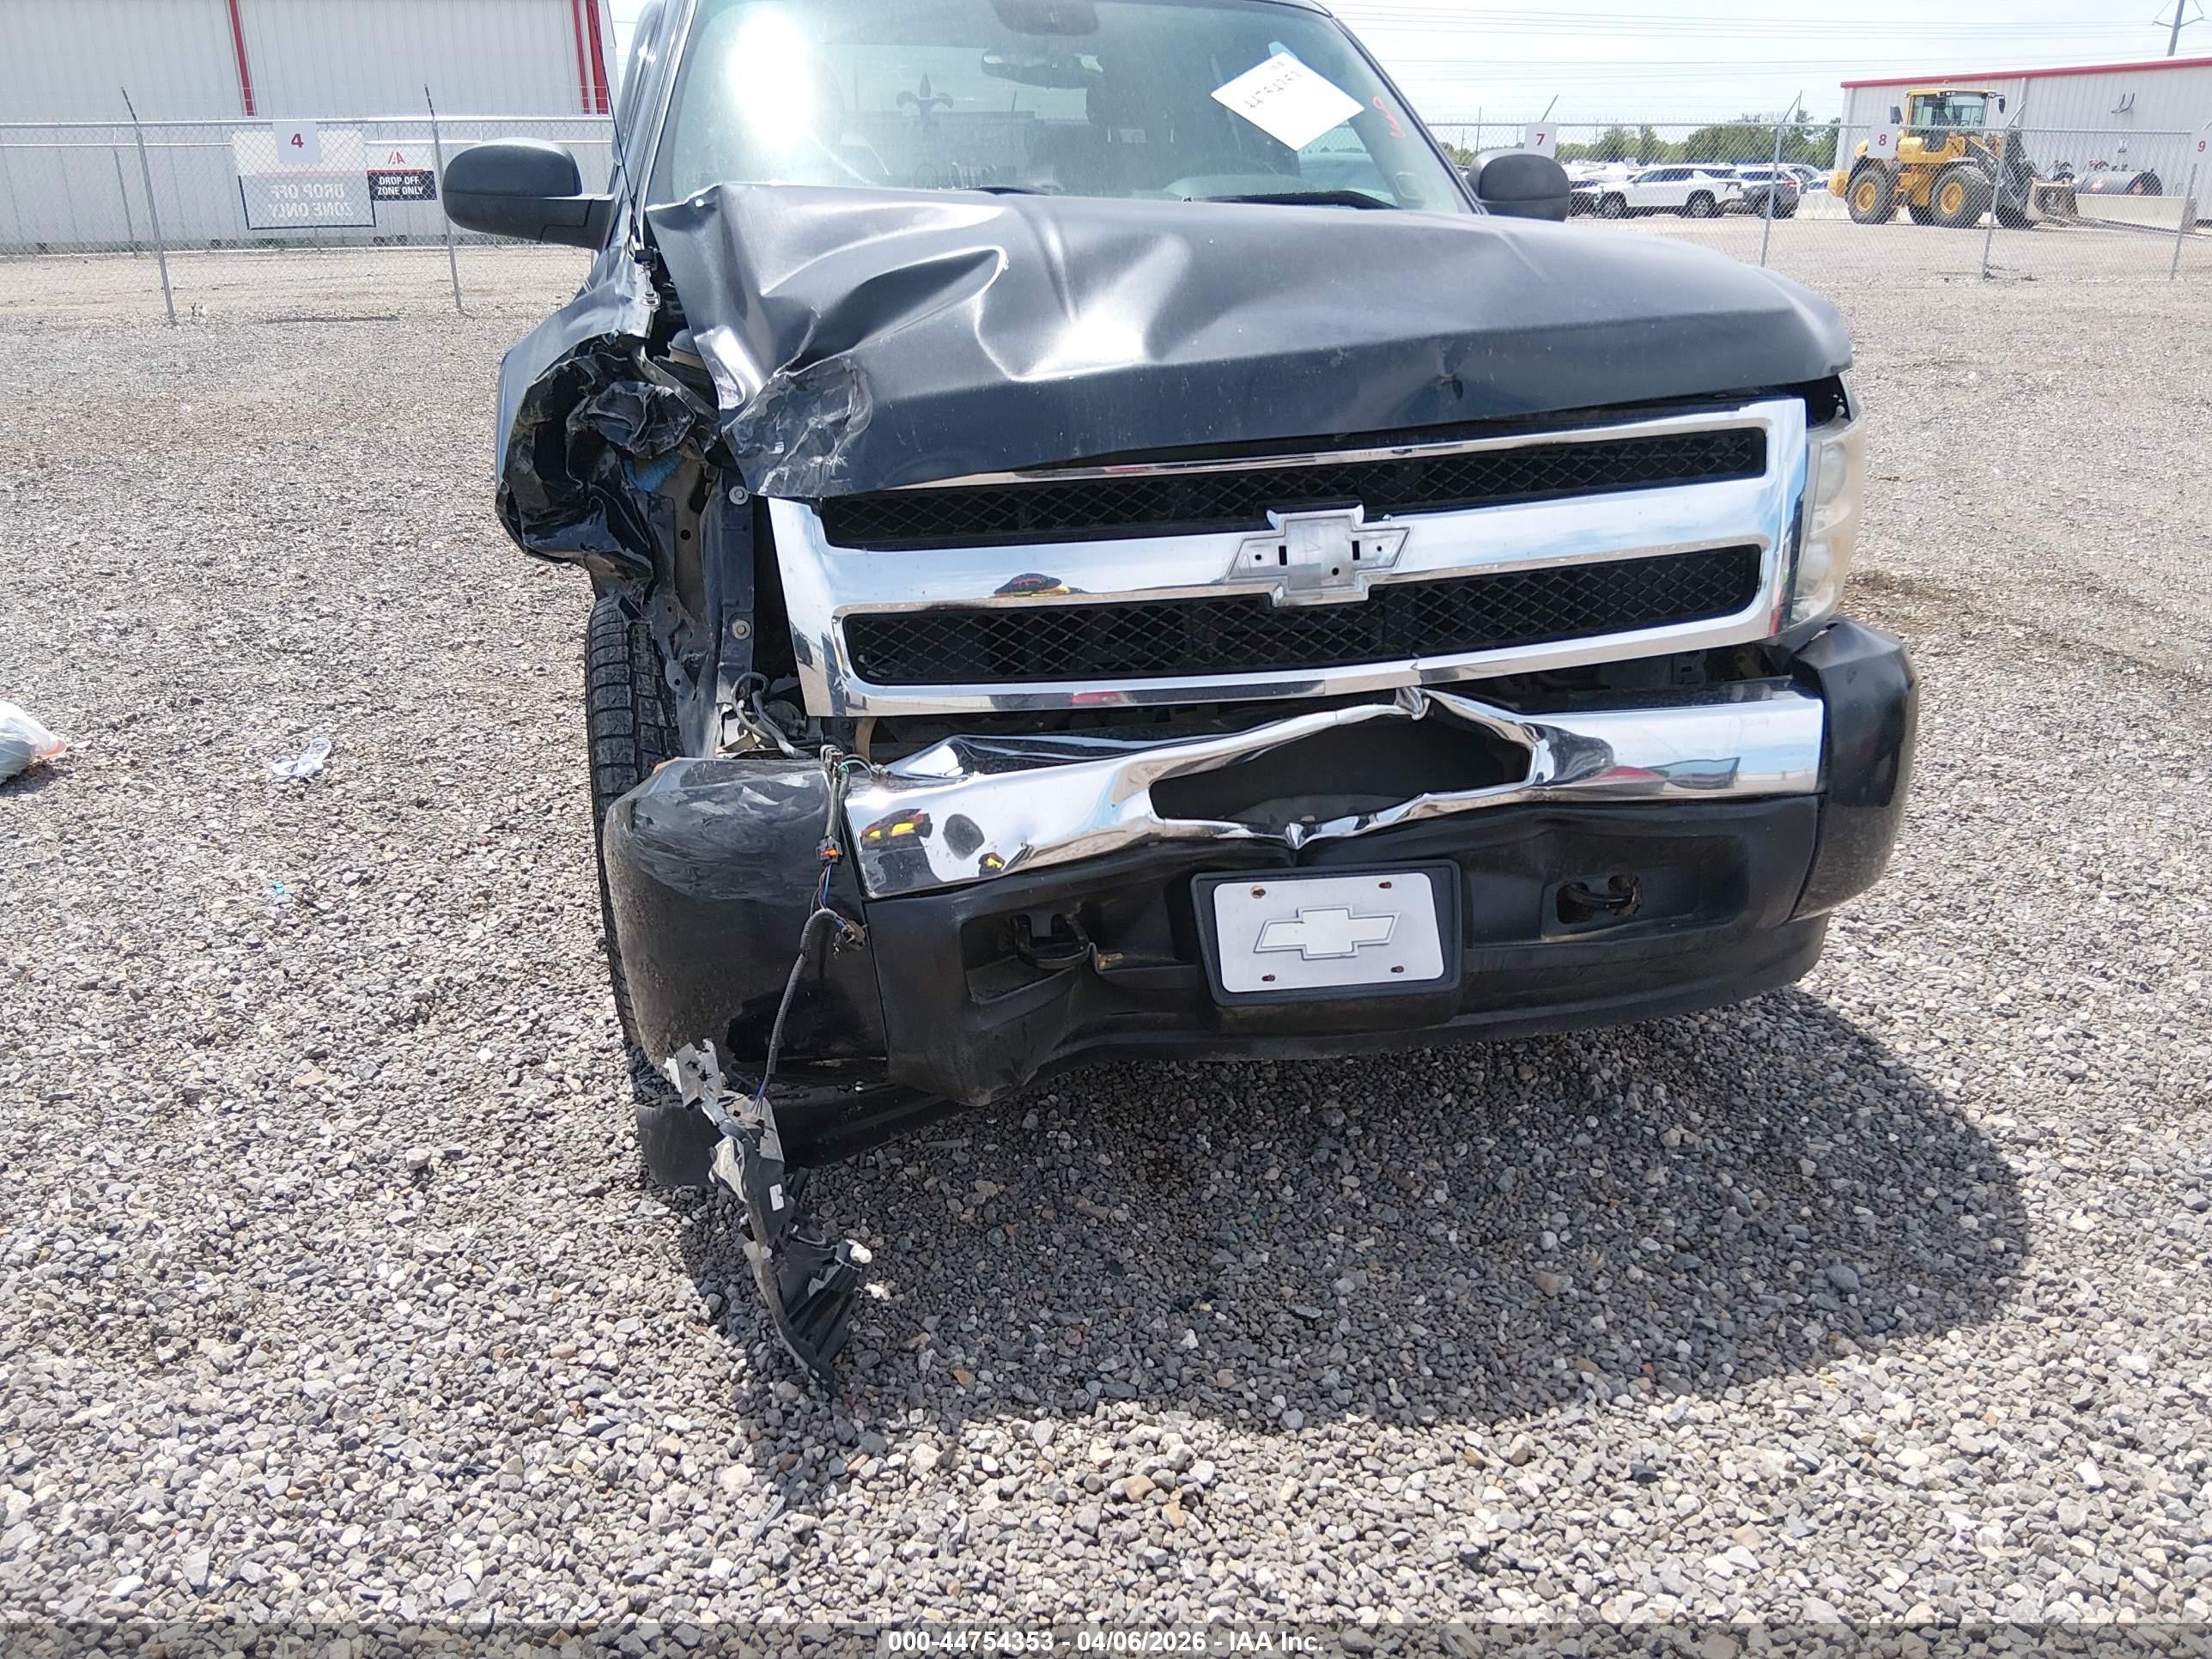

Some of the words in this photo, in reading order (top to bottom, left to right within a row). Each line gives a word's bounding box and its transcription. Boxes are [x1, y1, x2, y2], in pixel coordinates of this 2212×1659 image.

[290, 133, 304, 148] 4
[1536, 133, 1546, 146] 7
[1878, 134, 1887, 146] 8
[2197, 140, 2206, 153] 9
[380, 175, 403, 185] DROP
[404, 175, 420, 185] OFF
[377, 185, 400, 196] ZONE
[402, 185, 423, 195] ONLY
